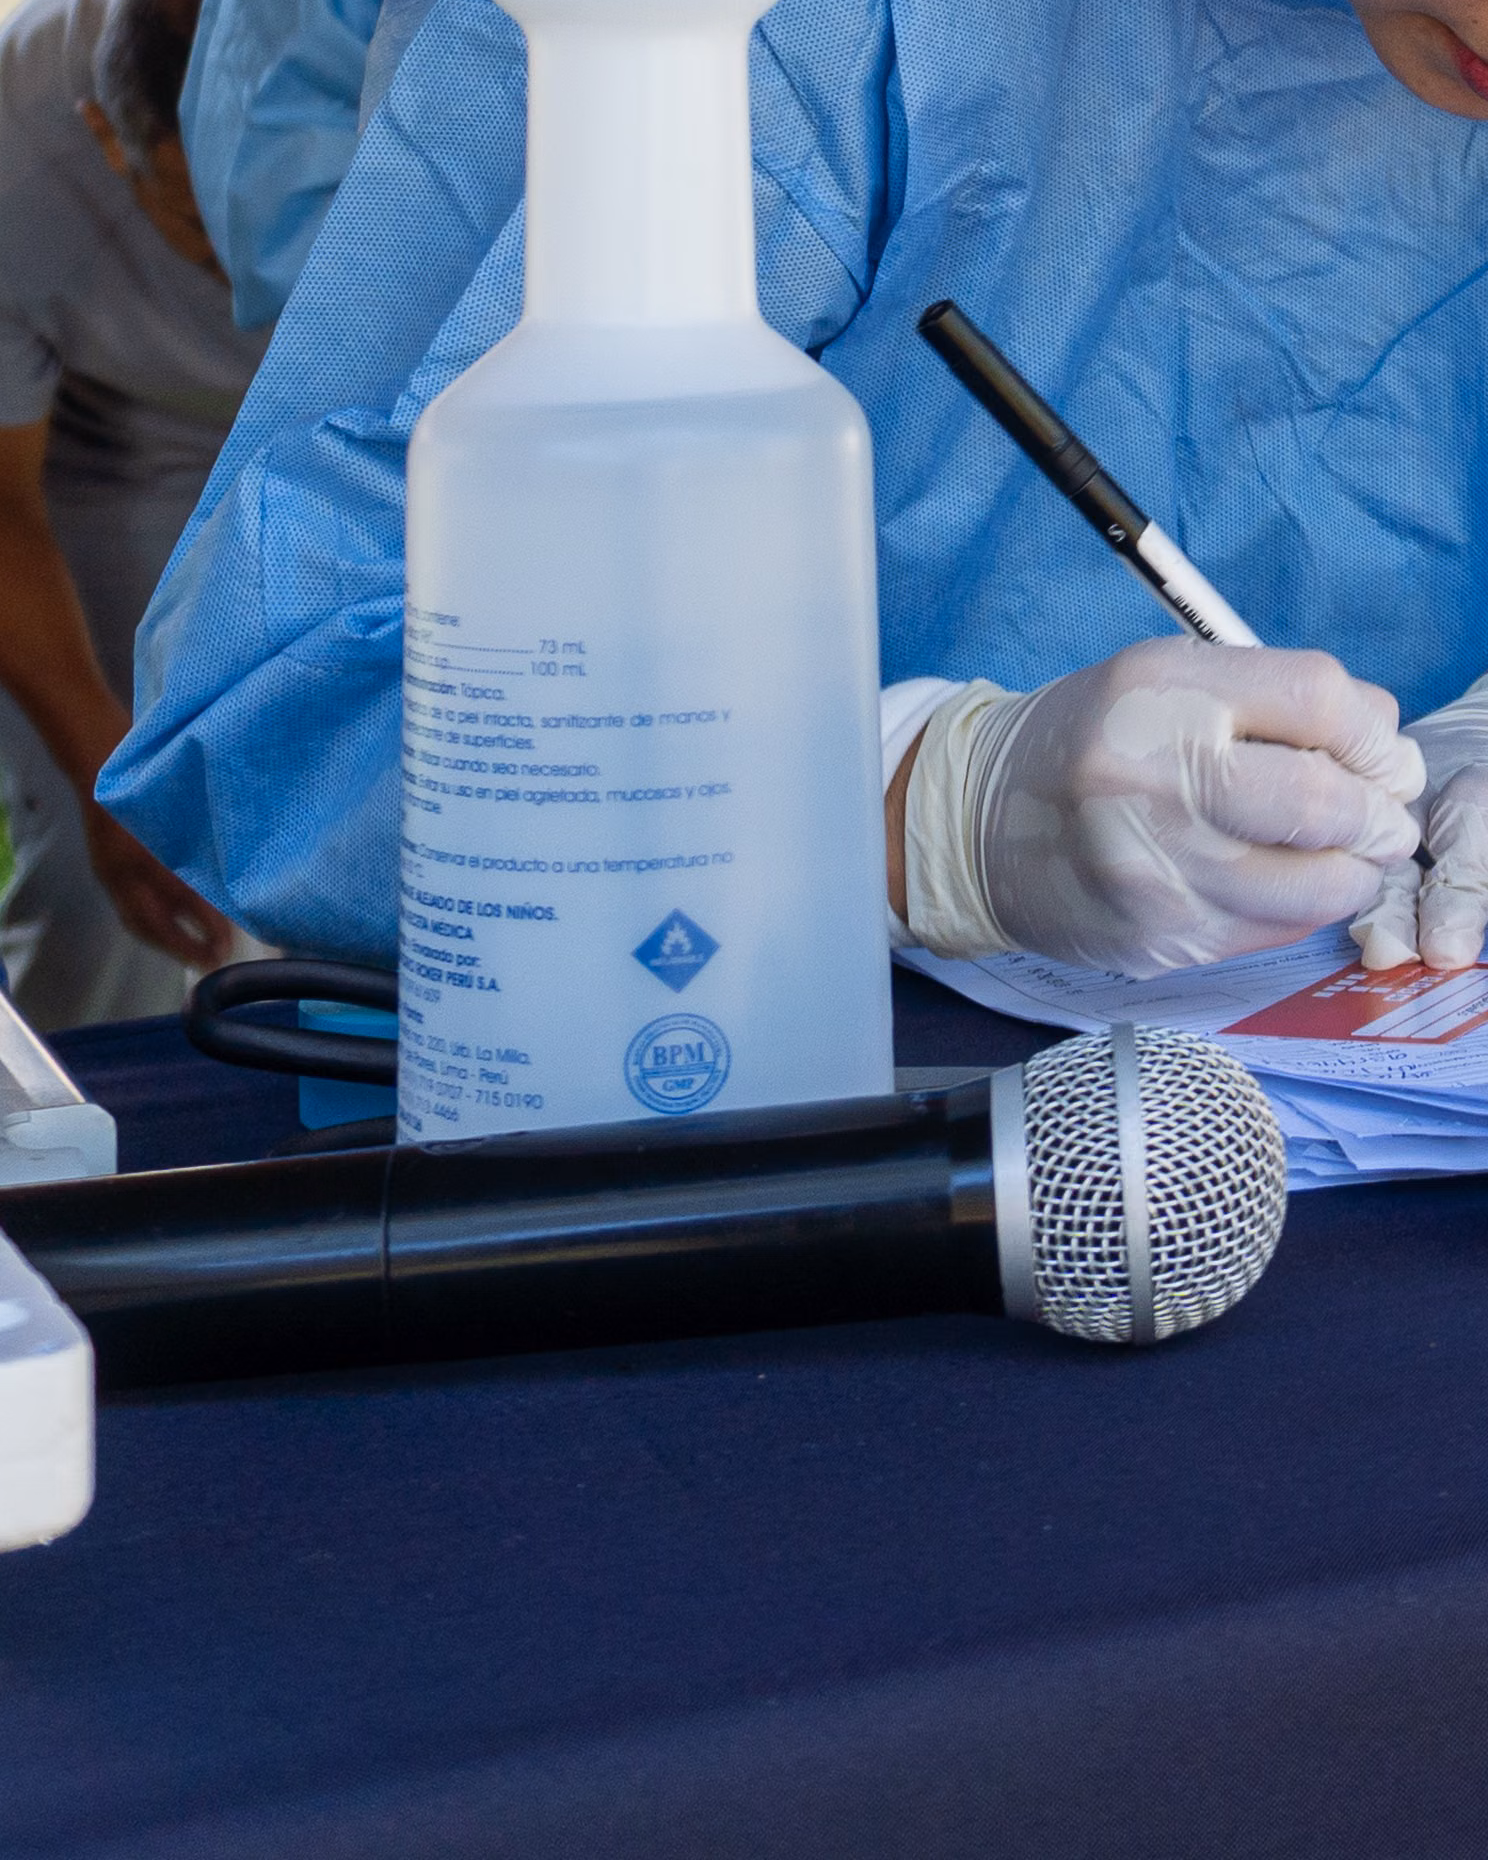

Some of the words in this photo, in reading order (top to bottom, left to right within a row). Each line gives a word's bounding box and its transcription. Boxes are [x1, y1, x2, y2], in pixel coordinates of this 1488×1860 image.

[539, 640, 557, 654] 73
[530, 661, 557, 677] 100
[540, 714, 624, 729] sanitizante
[629, 712, 653, 727] de
[659, 710, 717, 726] manos
[607, 786, 681, 803] mucosas
[476, 901, 502, 918] LOS
[652, 1042, 704, 1068] BPM
